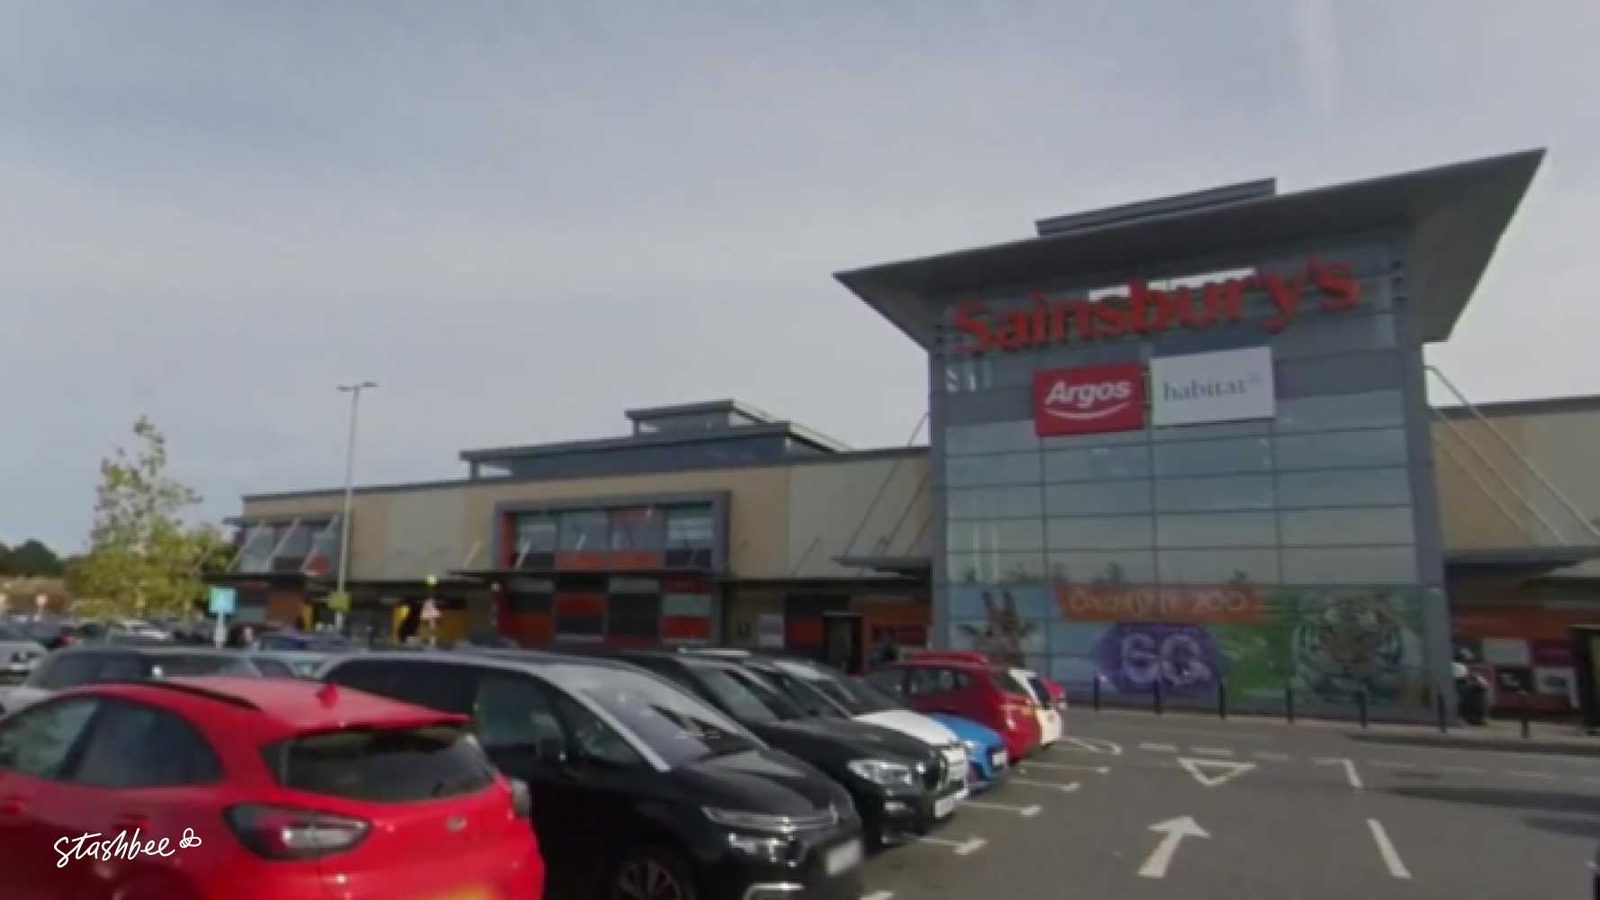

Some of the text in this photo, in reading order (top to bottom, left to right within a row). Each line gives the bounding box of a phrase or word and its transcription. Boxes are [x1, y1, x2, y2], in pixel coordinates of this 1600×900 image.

[953, 256, 1361, 353] Sainsbury's
[1045, 379, 1132, 408] Argos
[1163, 379, 1246, 402] habitat
